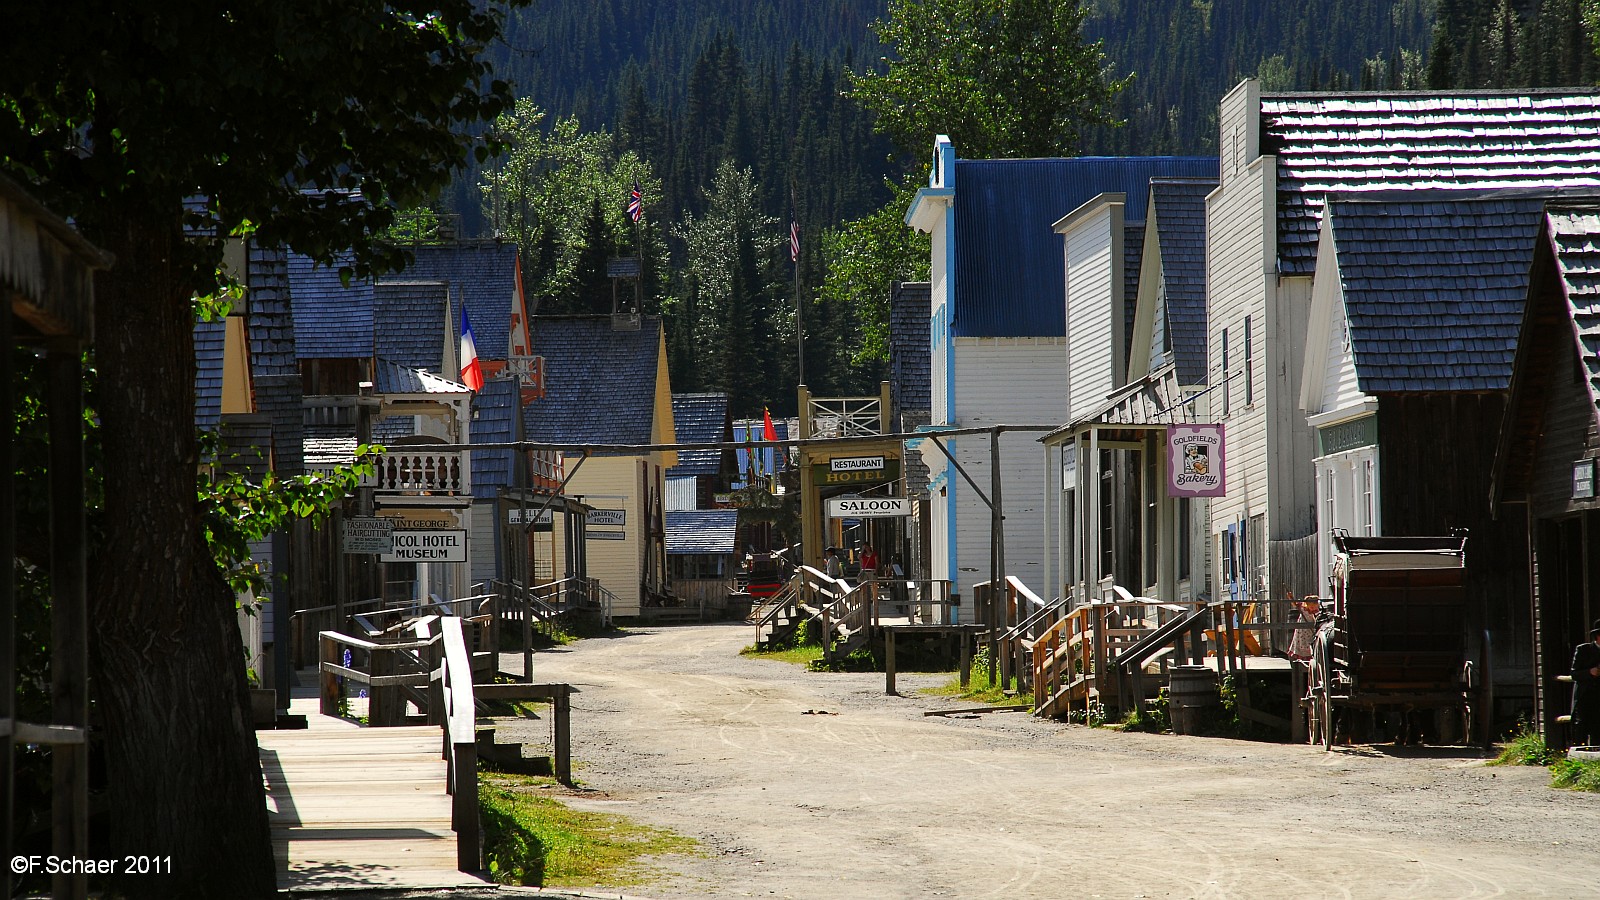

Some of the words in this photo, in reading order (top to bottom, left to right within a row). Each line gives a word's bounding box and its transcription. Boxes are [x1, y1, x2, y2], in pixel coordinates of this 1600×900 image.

[1174, 436, 1217, 445] GOLDFIELDS
[834, 460, 882, 469] RESTAURANT
[826, 471, 885, 482] HOTEL
[1177, 474, 1218, 485] Bakery
[840, 501, 902, 510] SALOON
[347, 521, 390, 530] FASHIONABLE
[391, 520, 413, 528] AINT
[413, 520, 450, 528] GEORGE
[347, 529, 390, 538] HAIRCUTTING
[422, 535, 460, 547] HOTEL
[395, 549, 448, 558] MUSEUM
